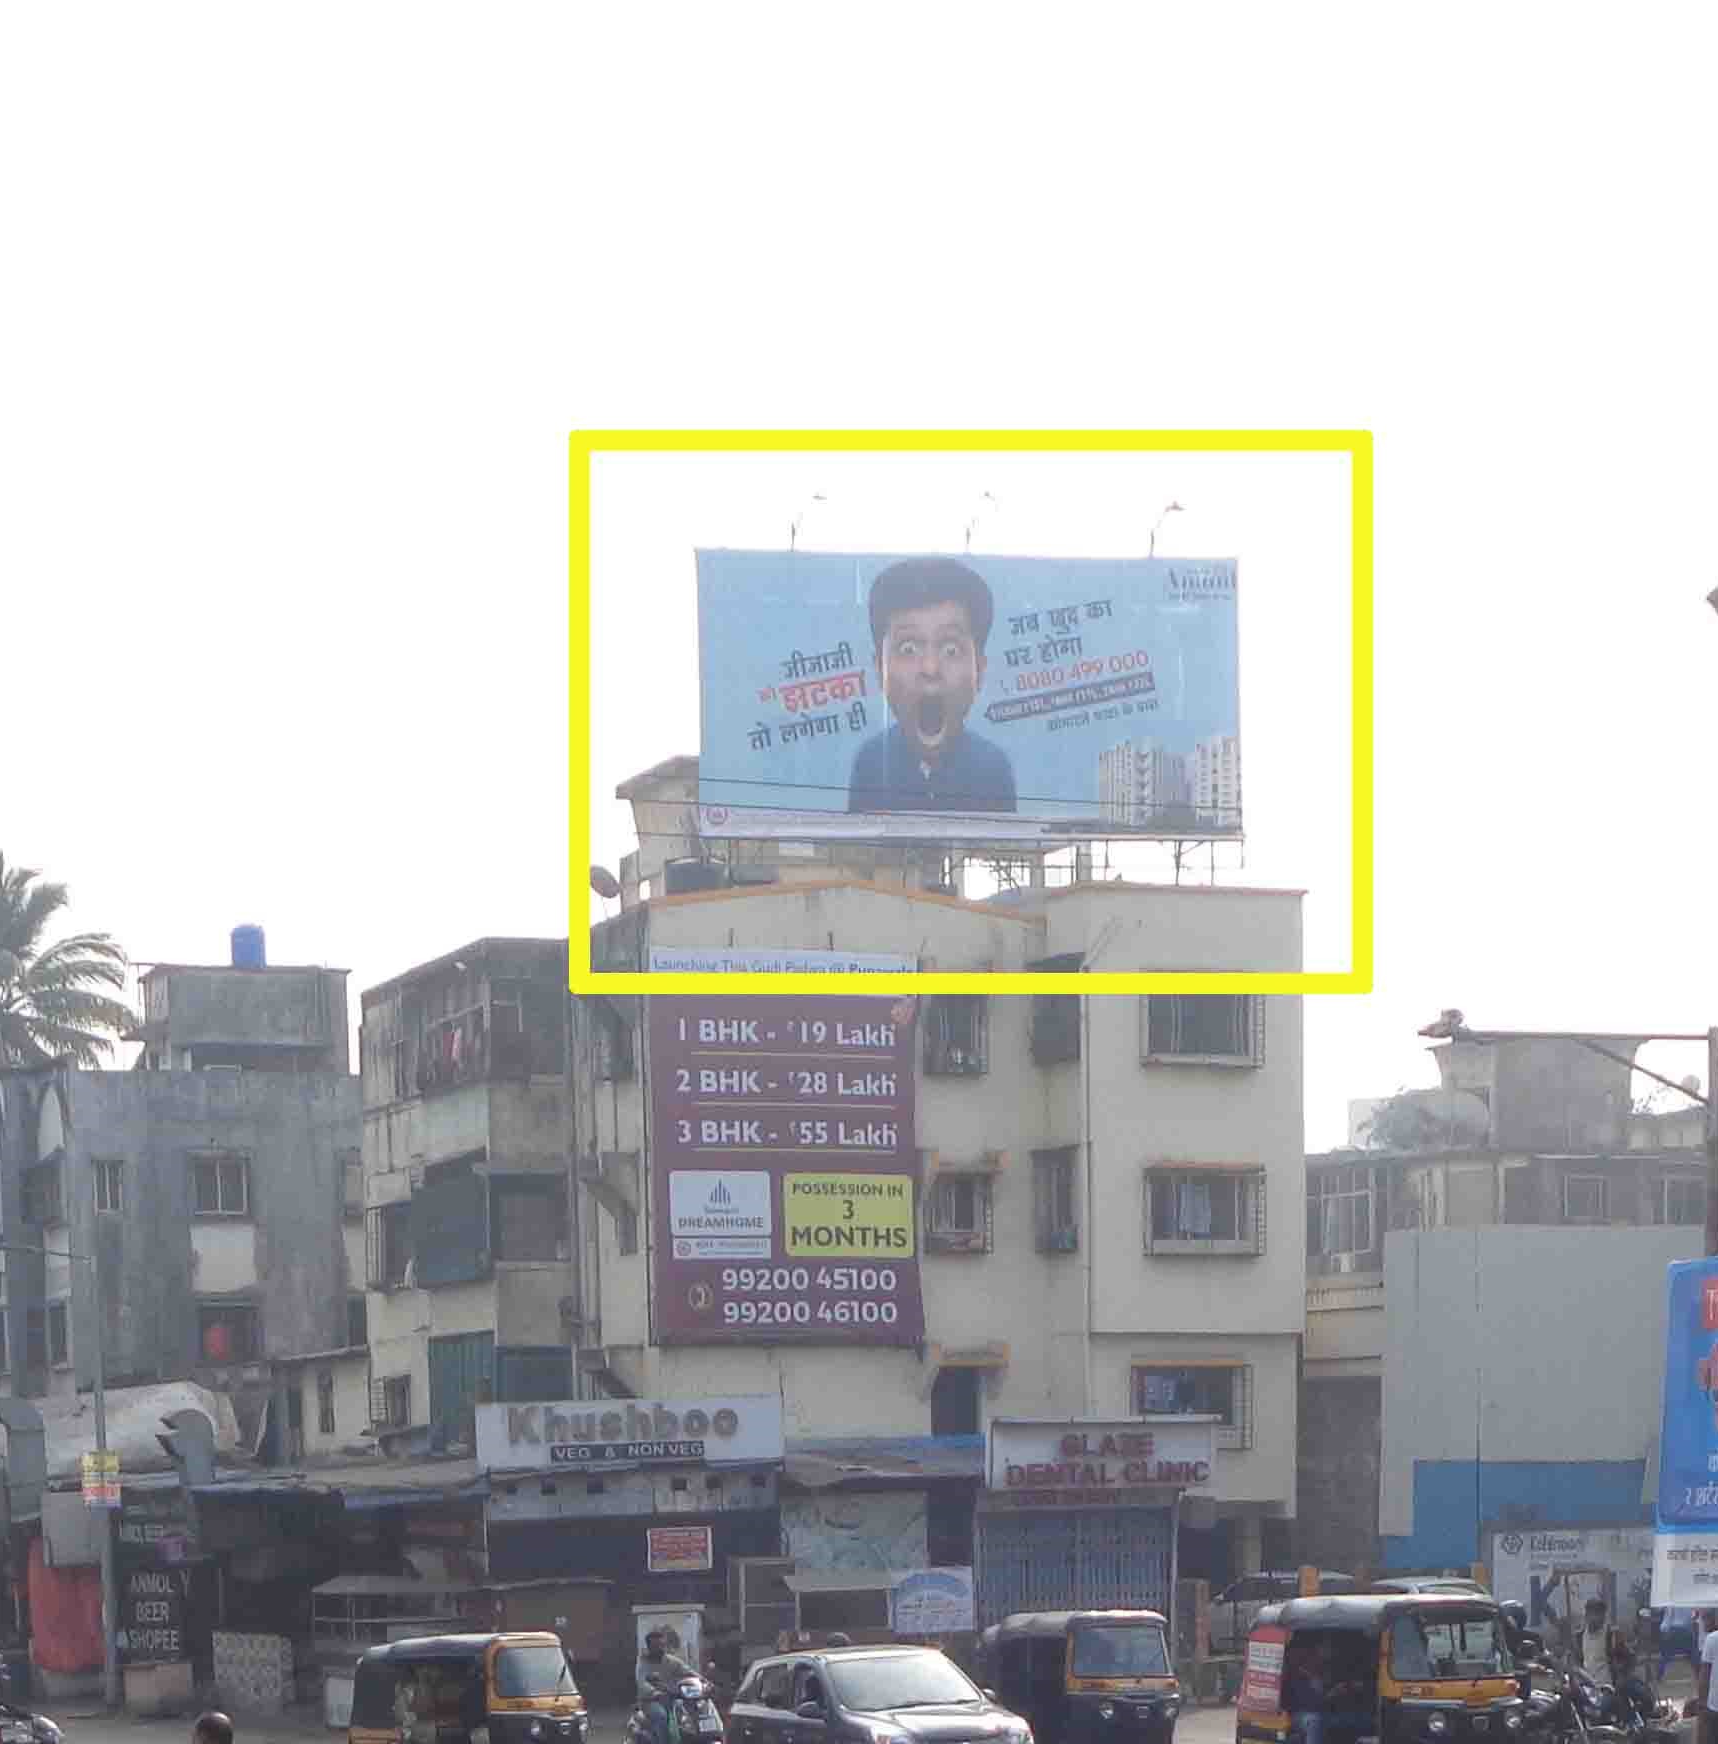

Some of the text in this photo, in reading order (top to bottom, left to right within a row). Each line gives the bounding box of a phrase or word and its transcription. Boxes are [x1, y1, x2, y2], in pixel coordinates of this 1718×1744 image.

[781, 640, 854, 679] जीजाजी
[779, 670, 868, 713] झटका
[779, 711, 841, 744] लगेगा
[679, 1018, 685, 1041] 1
[699, 1020, 759, 1043] BHK
[676, 1070, 691, 1092] 2
[700, 1070, 761, 1093] BHK
[678, 1120, 692, 1143] 3
[701, 1120, 762, 1143] BHK
[792, 1183, 903, 1197] POSSESSION IN
[842, 1199, 855, 1220] 3
[678, 1217, 764, 1229] DREAMHOME
[790, 1226, 908, 1248] MONTHS
[722, 1268, 897, 1291] 99200 45100
[723, 1302, 898, 1323] 99200 46100
[508, 1401, 739, 1446] Khushboo
[554, 1447, 591, 1459] VEG
[628, 1442, 665, 1457] NON
[668, 1441, 703, 1456] VEG
[1004, 1460, 1210, 1487] DENTAL CLINIC
